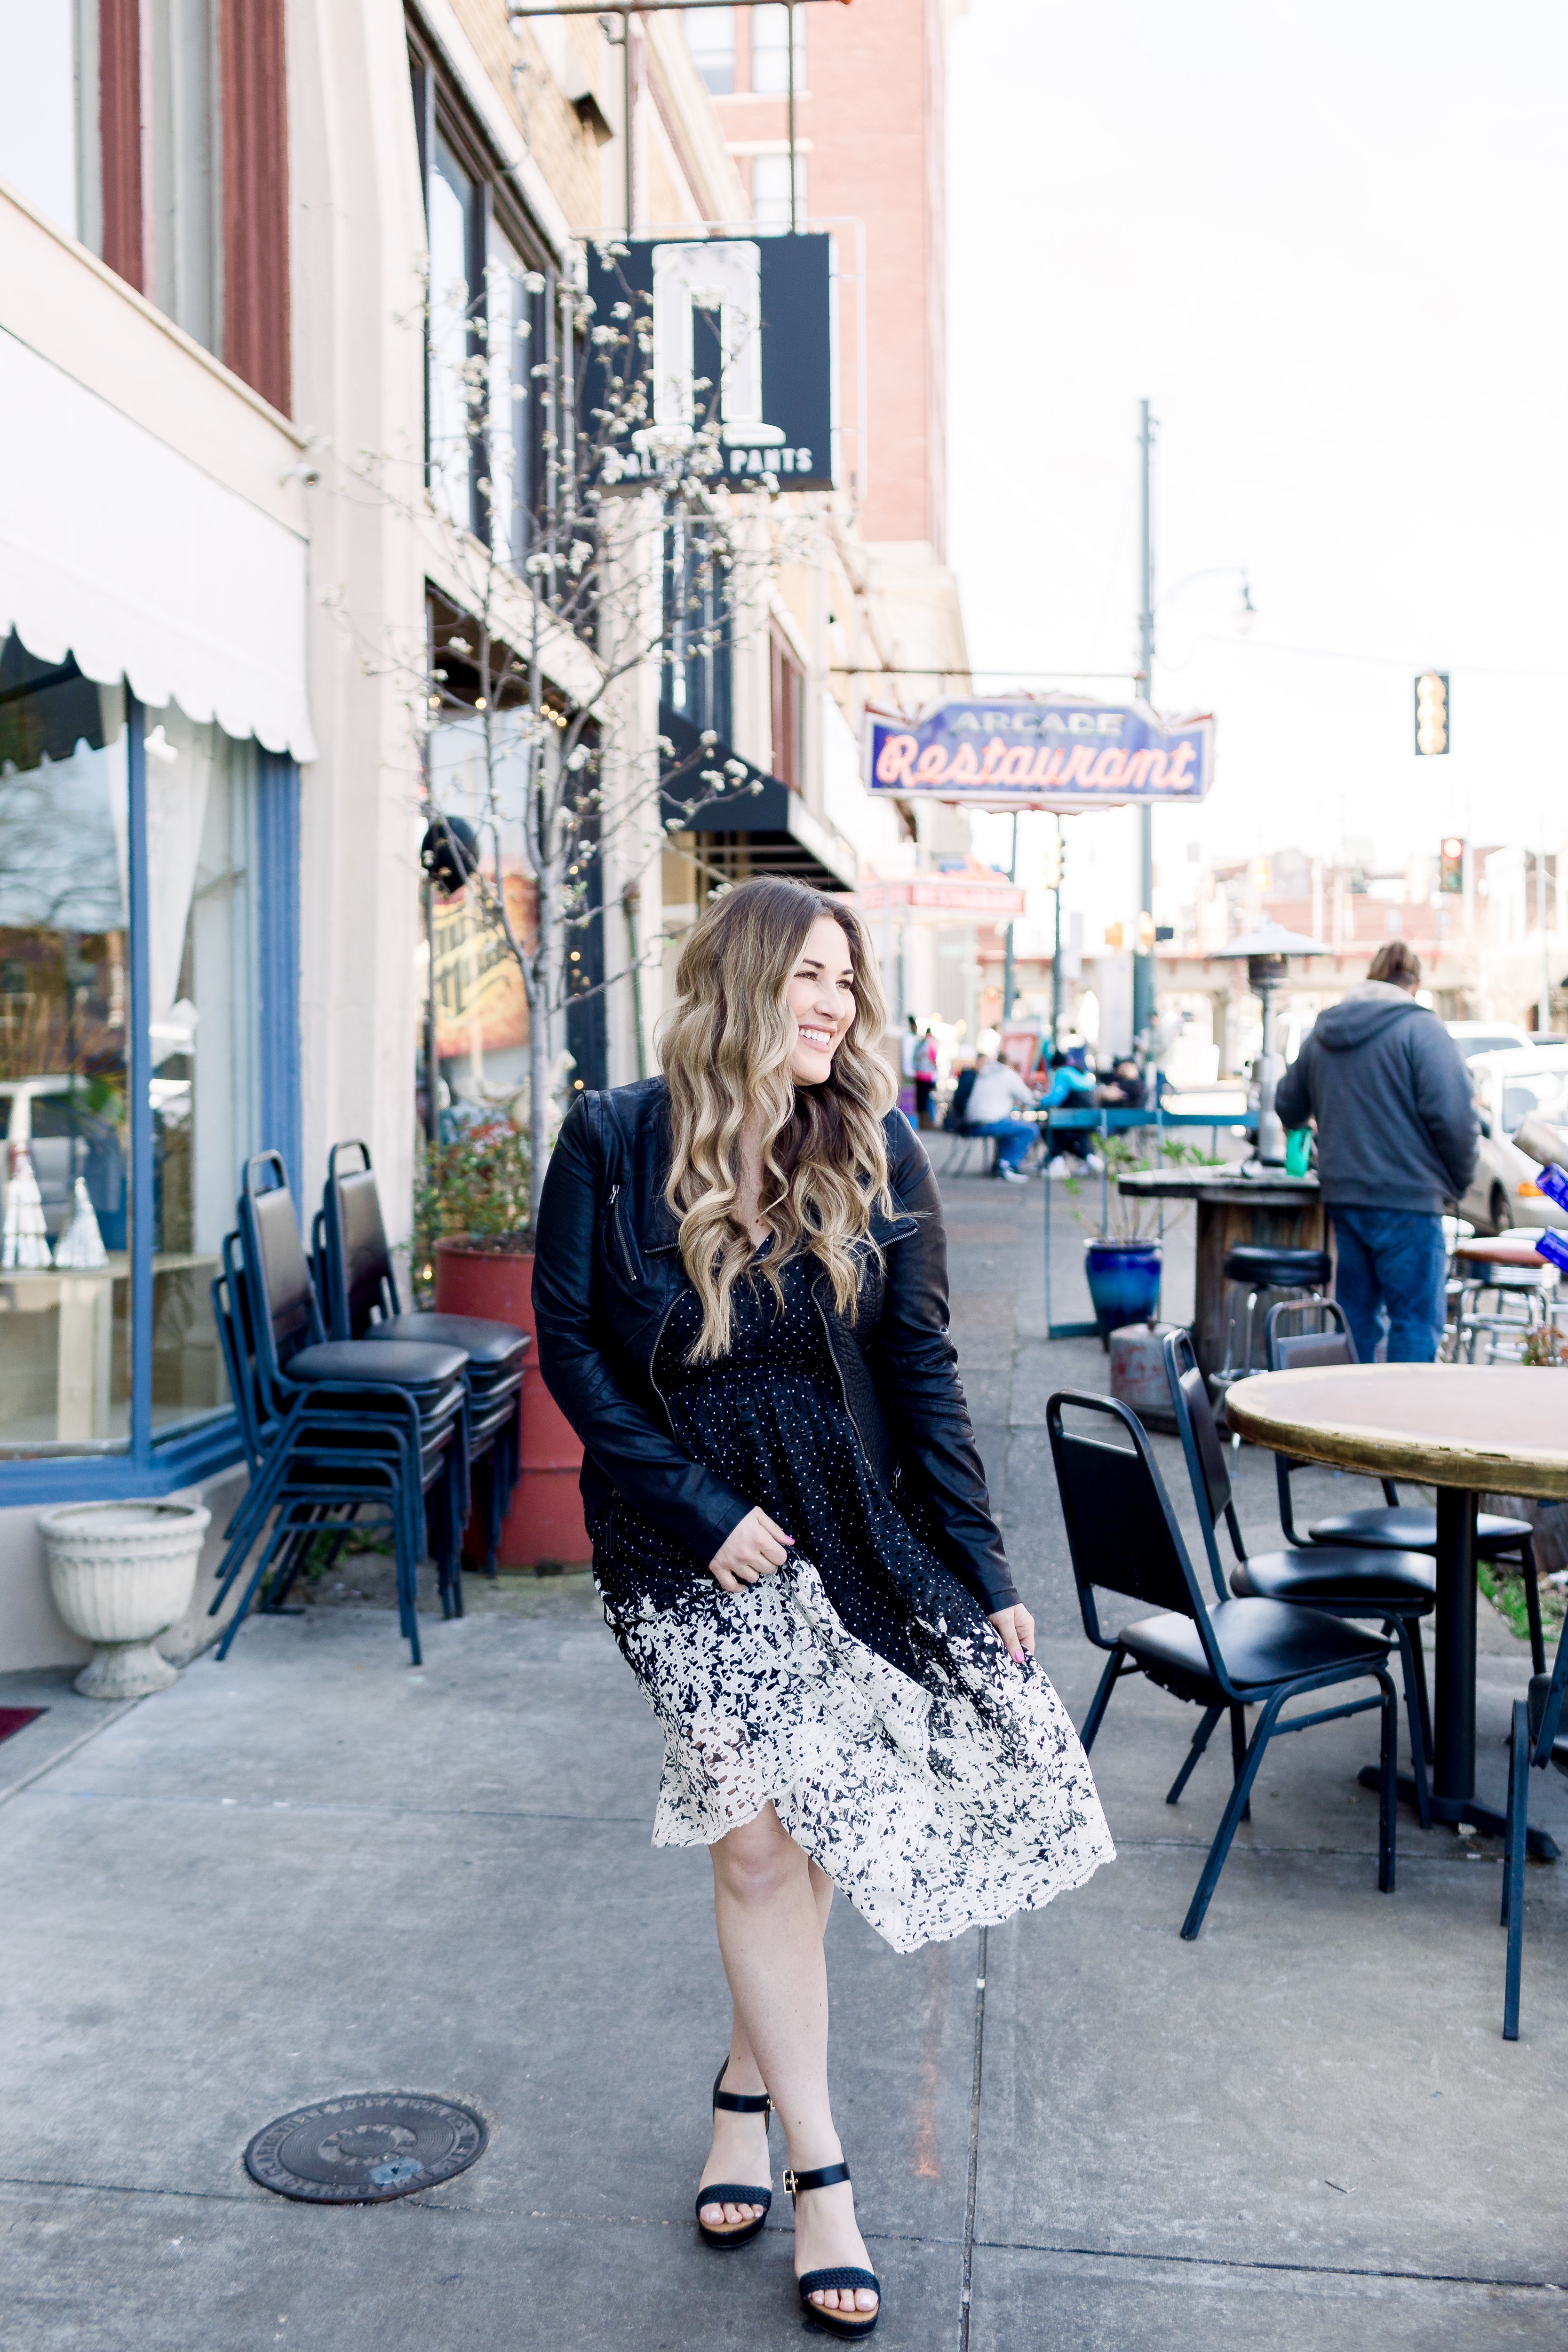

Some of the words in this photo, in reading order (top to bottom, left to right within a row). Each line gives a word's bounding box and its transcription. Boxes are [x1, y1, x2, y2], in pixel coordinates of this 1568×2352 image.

[730, 447, 813, 474] PANTS
[950, 711, 1126, 737] ARCADE
[876, 734, 1195, 790] Restaurant
